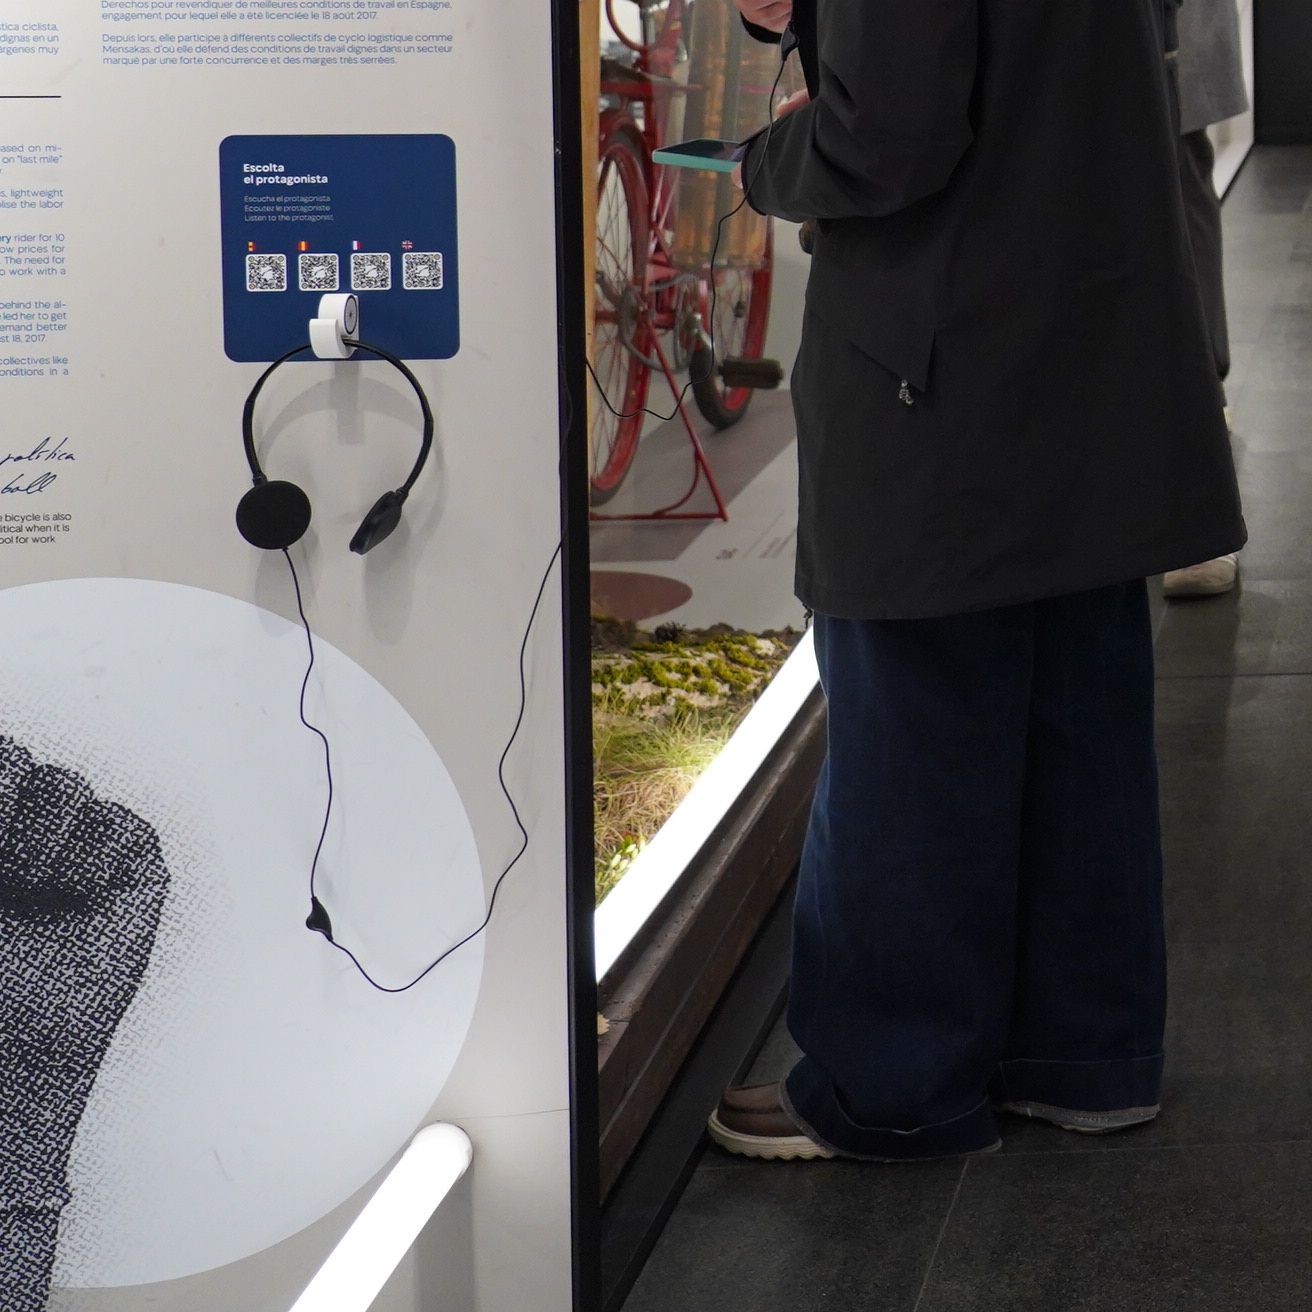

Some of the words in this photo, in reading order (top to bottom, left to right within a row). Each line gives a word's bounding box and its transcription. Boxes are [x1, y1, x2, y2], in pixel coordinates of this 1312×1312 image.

[243, 163, 285, 173] Escolta
[243, 175, 254, 184] el
[255, 174, 329, 186] protagonista
[10, 188, 64, 198] lightweight
[20, 200, 36, 209] the
[39, 200, 64, 209] labor
[284, 196, 331, 204] protagonista
[244, 214, 267, 222] Listen
[278, 214, 291, 222] the
[14, 233, 36, 242] rider
[39, 233, 52, 242] for
[17, 245, 49, 256] prices
[52, 245, 65, 254] for
[4, 513, 41, 523] bicycle
[42, 513, 51, 522] is
[52, 513, 72, 522] also
[25, 524, 52, 533] when
[15, 536, 30, 544] for
[31, 535, 56, 544] work
